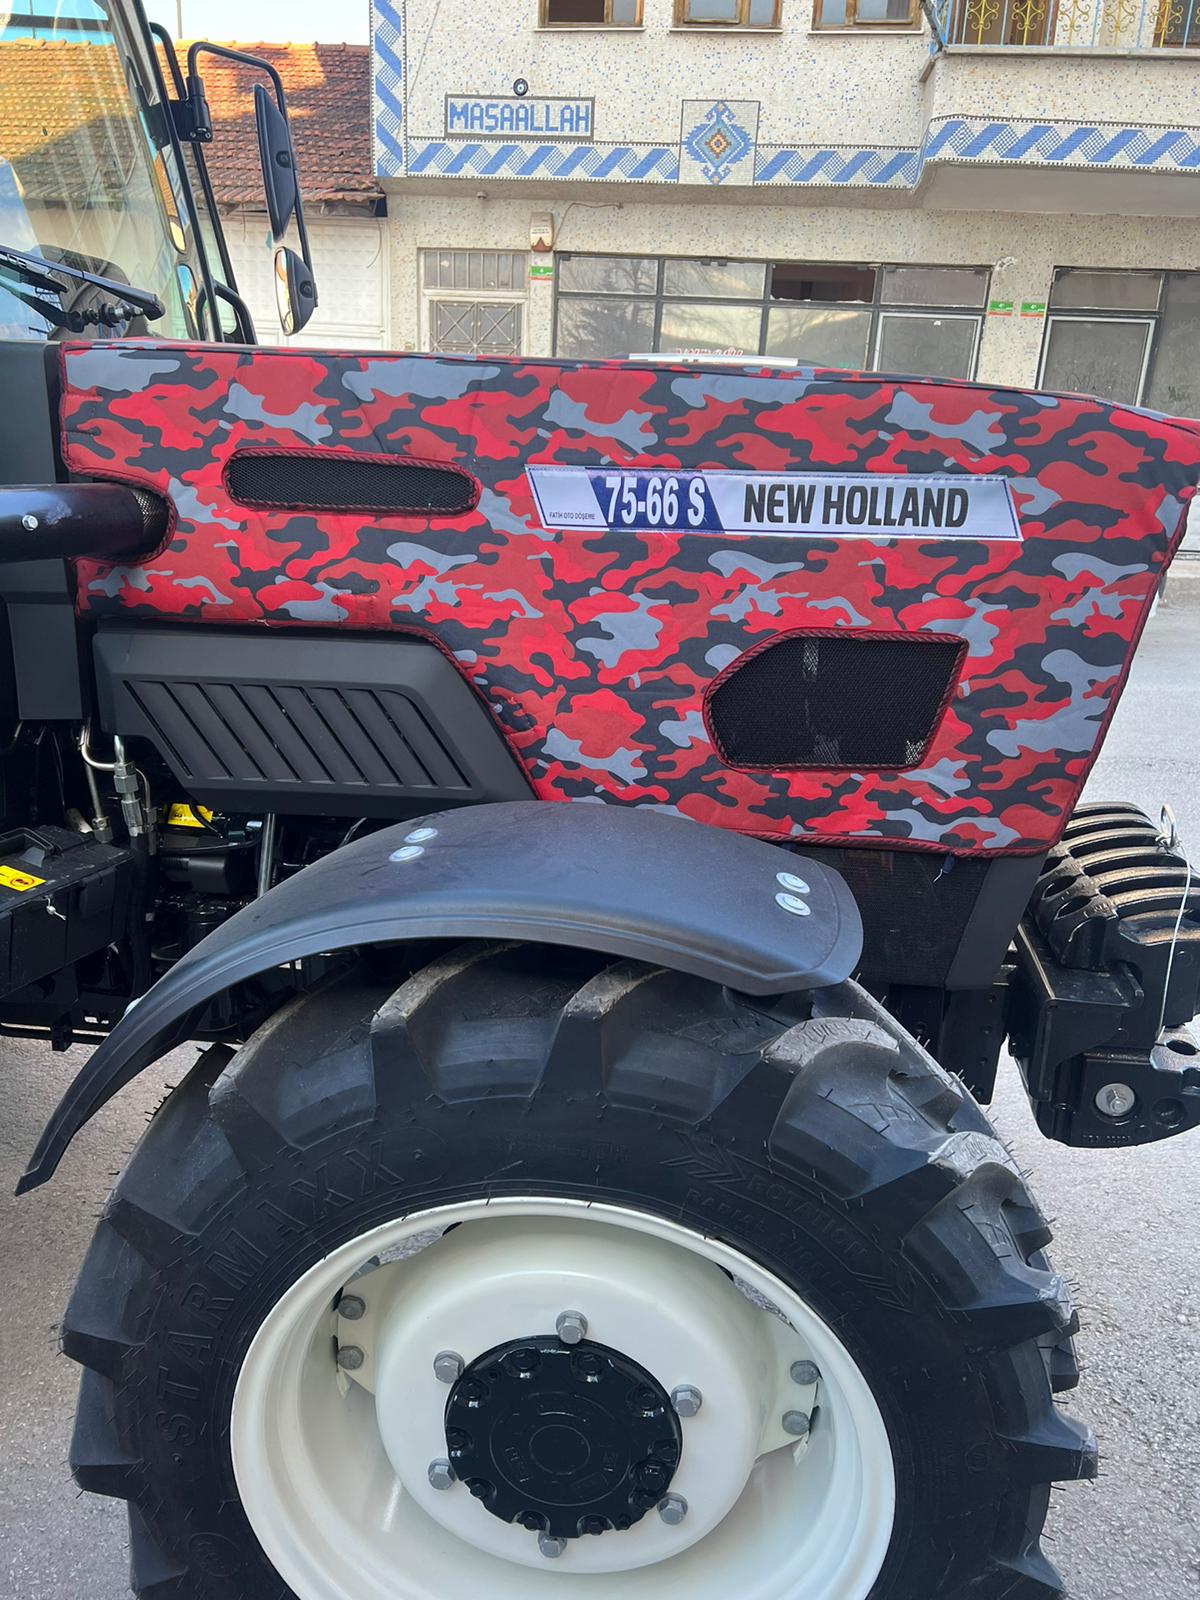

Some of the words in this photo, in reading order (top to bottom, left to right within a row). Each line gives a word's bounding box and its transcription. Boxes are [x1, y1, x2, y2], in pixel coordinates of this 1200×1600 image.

[450, 102, 590, 132] MAŞAALLAH
[563, 511, 575, 520] OTO
[605, 476, 679, 525] 75-66
[687, 476, 706, 526] S
[743, 483, 817, 524] NEW
[822, 485, 970, 528] HOLLAND
[746, 1173, 869, 1255] ROTATION
[154, 1138, 406, 1447] STARMAXX
